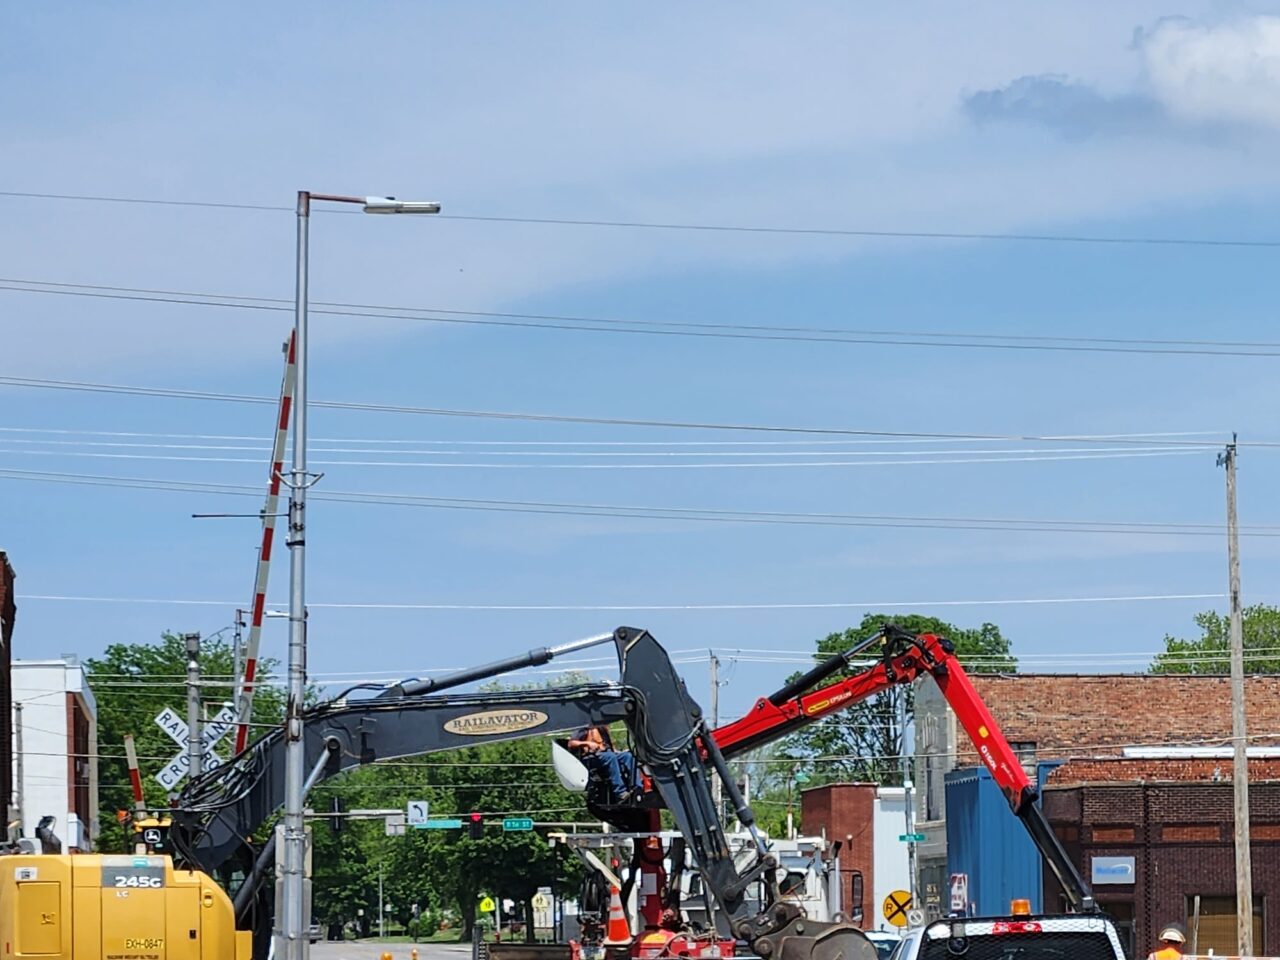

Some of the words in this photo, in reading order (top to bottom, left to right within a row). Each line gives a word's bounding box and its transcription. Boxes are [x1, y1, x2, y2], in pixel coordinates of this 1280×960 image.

[453, 712, 538, 728] RAILAVATOR
[161, 712, 233, 785] CROSING
[115, 876, 161, 888] 245G
[885, 903, 893, 912] R
